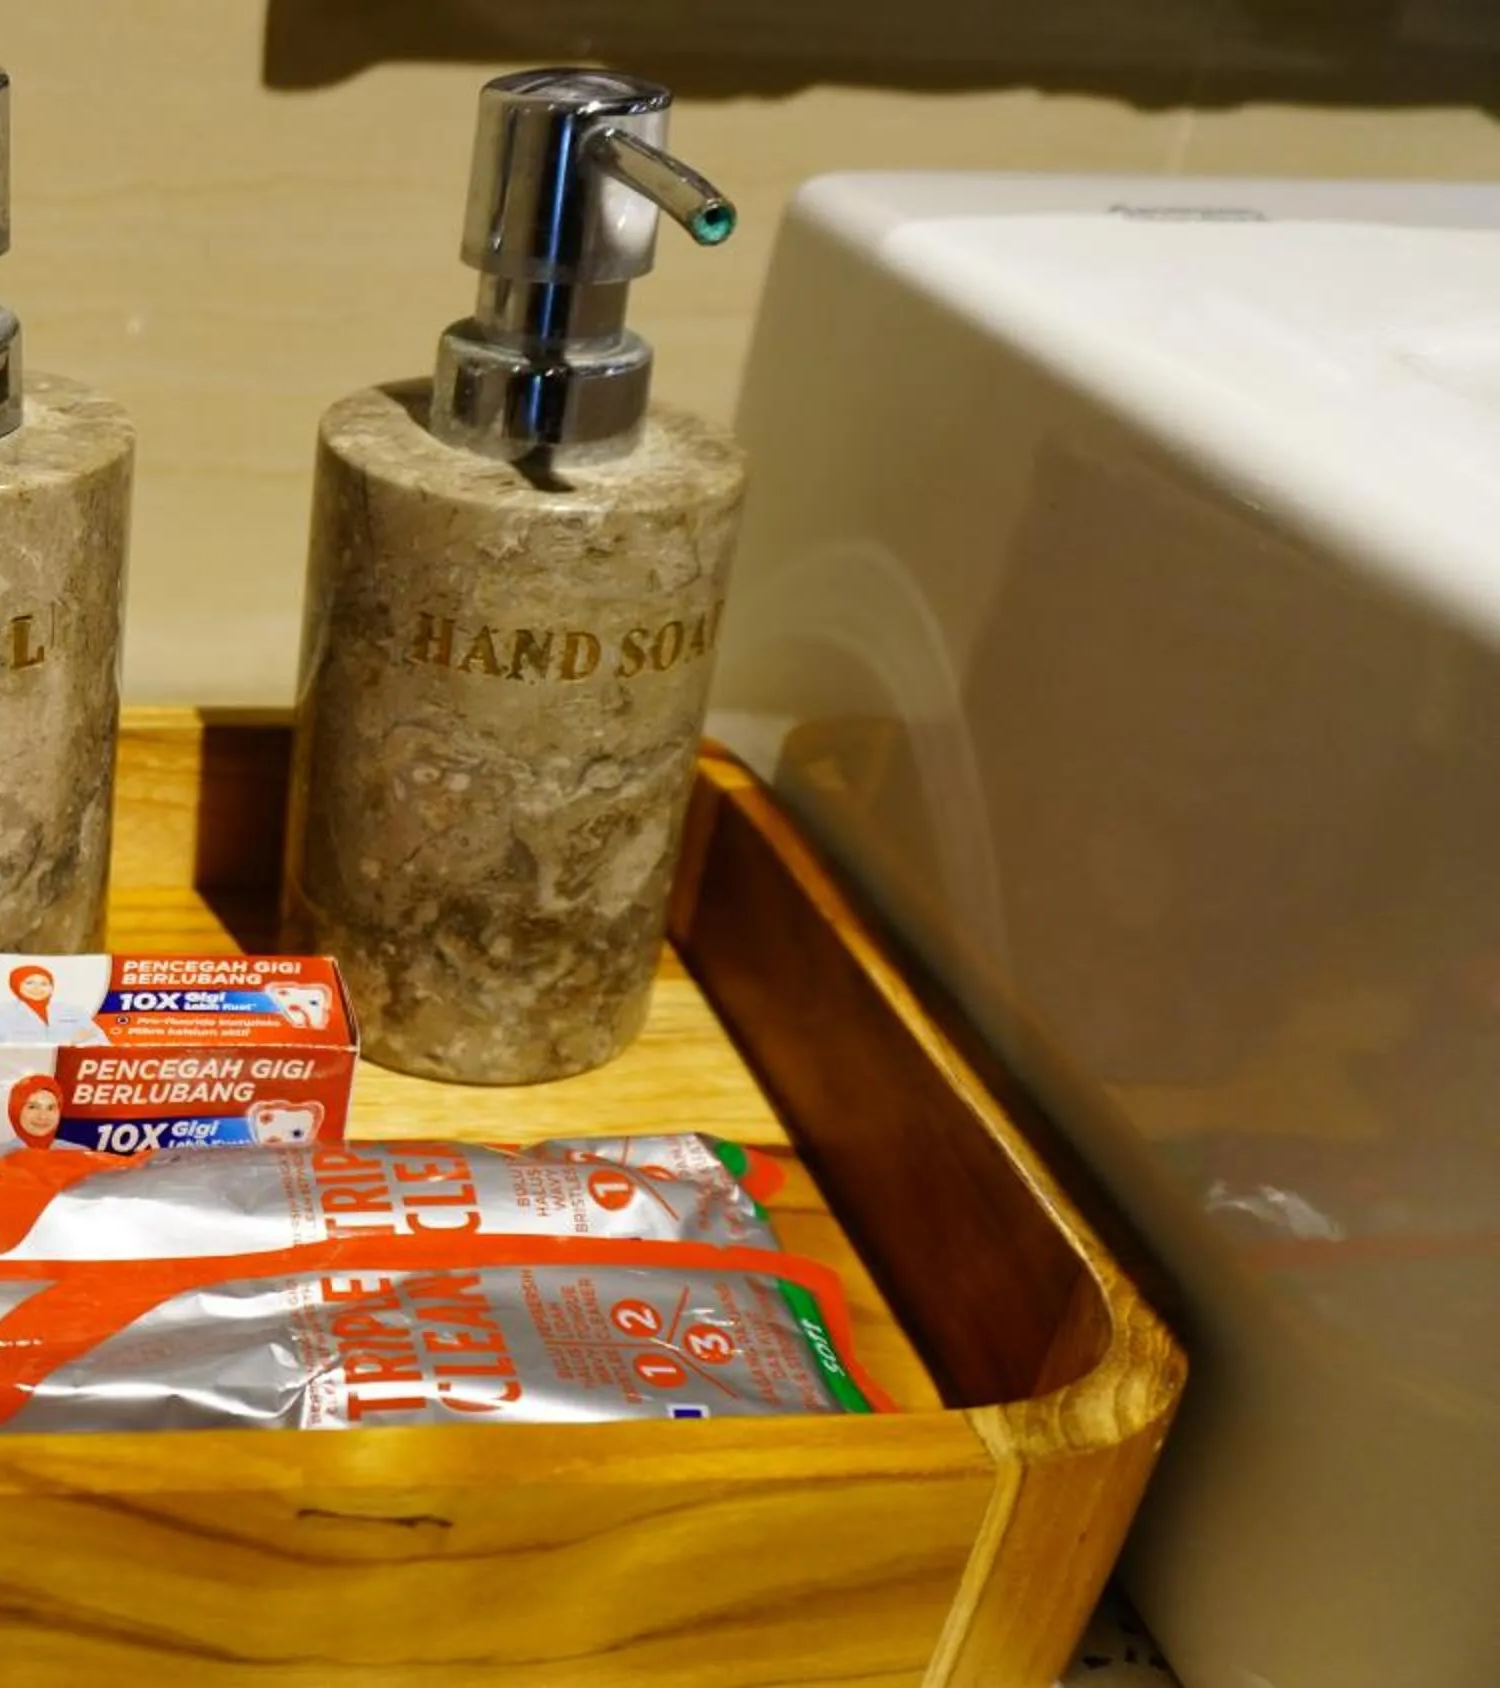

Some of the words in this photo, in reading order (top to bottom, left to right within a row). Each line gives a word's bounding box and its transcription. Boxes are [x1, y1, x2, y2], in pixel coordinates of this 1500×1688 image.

[404, 610, 602, 682] HAND
[121, 973, 262, 986] BERLUBANG
[122, 960, 249, 974] PENCEGAH
[254, 961, 302, 975] GIGI
[119, 992, 182, 1011] 10X
[76, 1059, 243, 1081] PENCEGAH
[251, 1059, 315, 1080] GIGI
[71, 1082, 256, 1106] BERLUBANG
[97, 1122, 170, 1153] 10X
[171, 1119, 220, 1139] Gigi
[593, 1182, 630, 1198] 1
[616, 1308, 656, 1334] 2
[320, 1276, 427, 1421] TRIPLE
[403, 1268, 522, 1414] CLEAN
[689, 1332, 731, 1358] 3
[643, 1361, 678, 1382] 1
